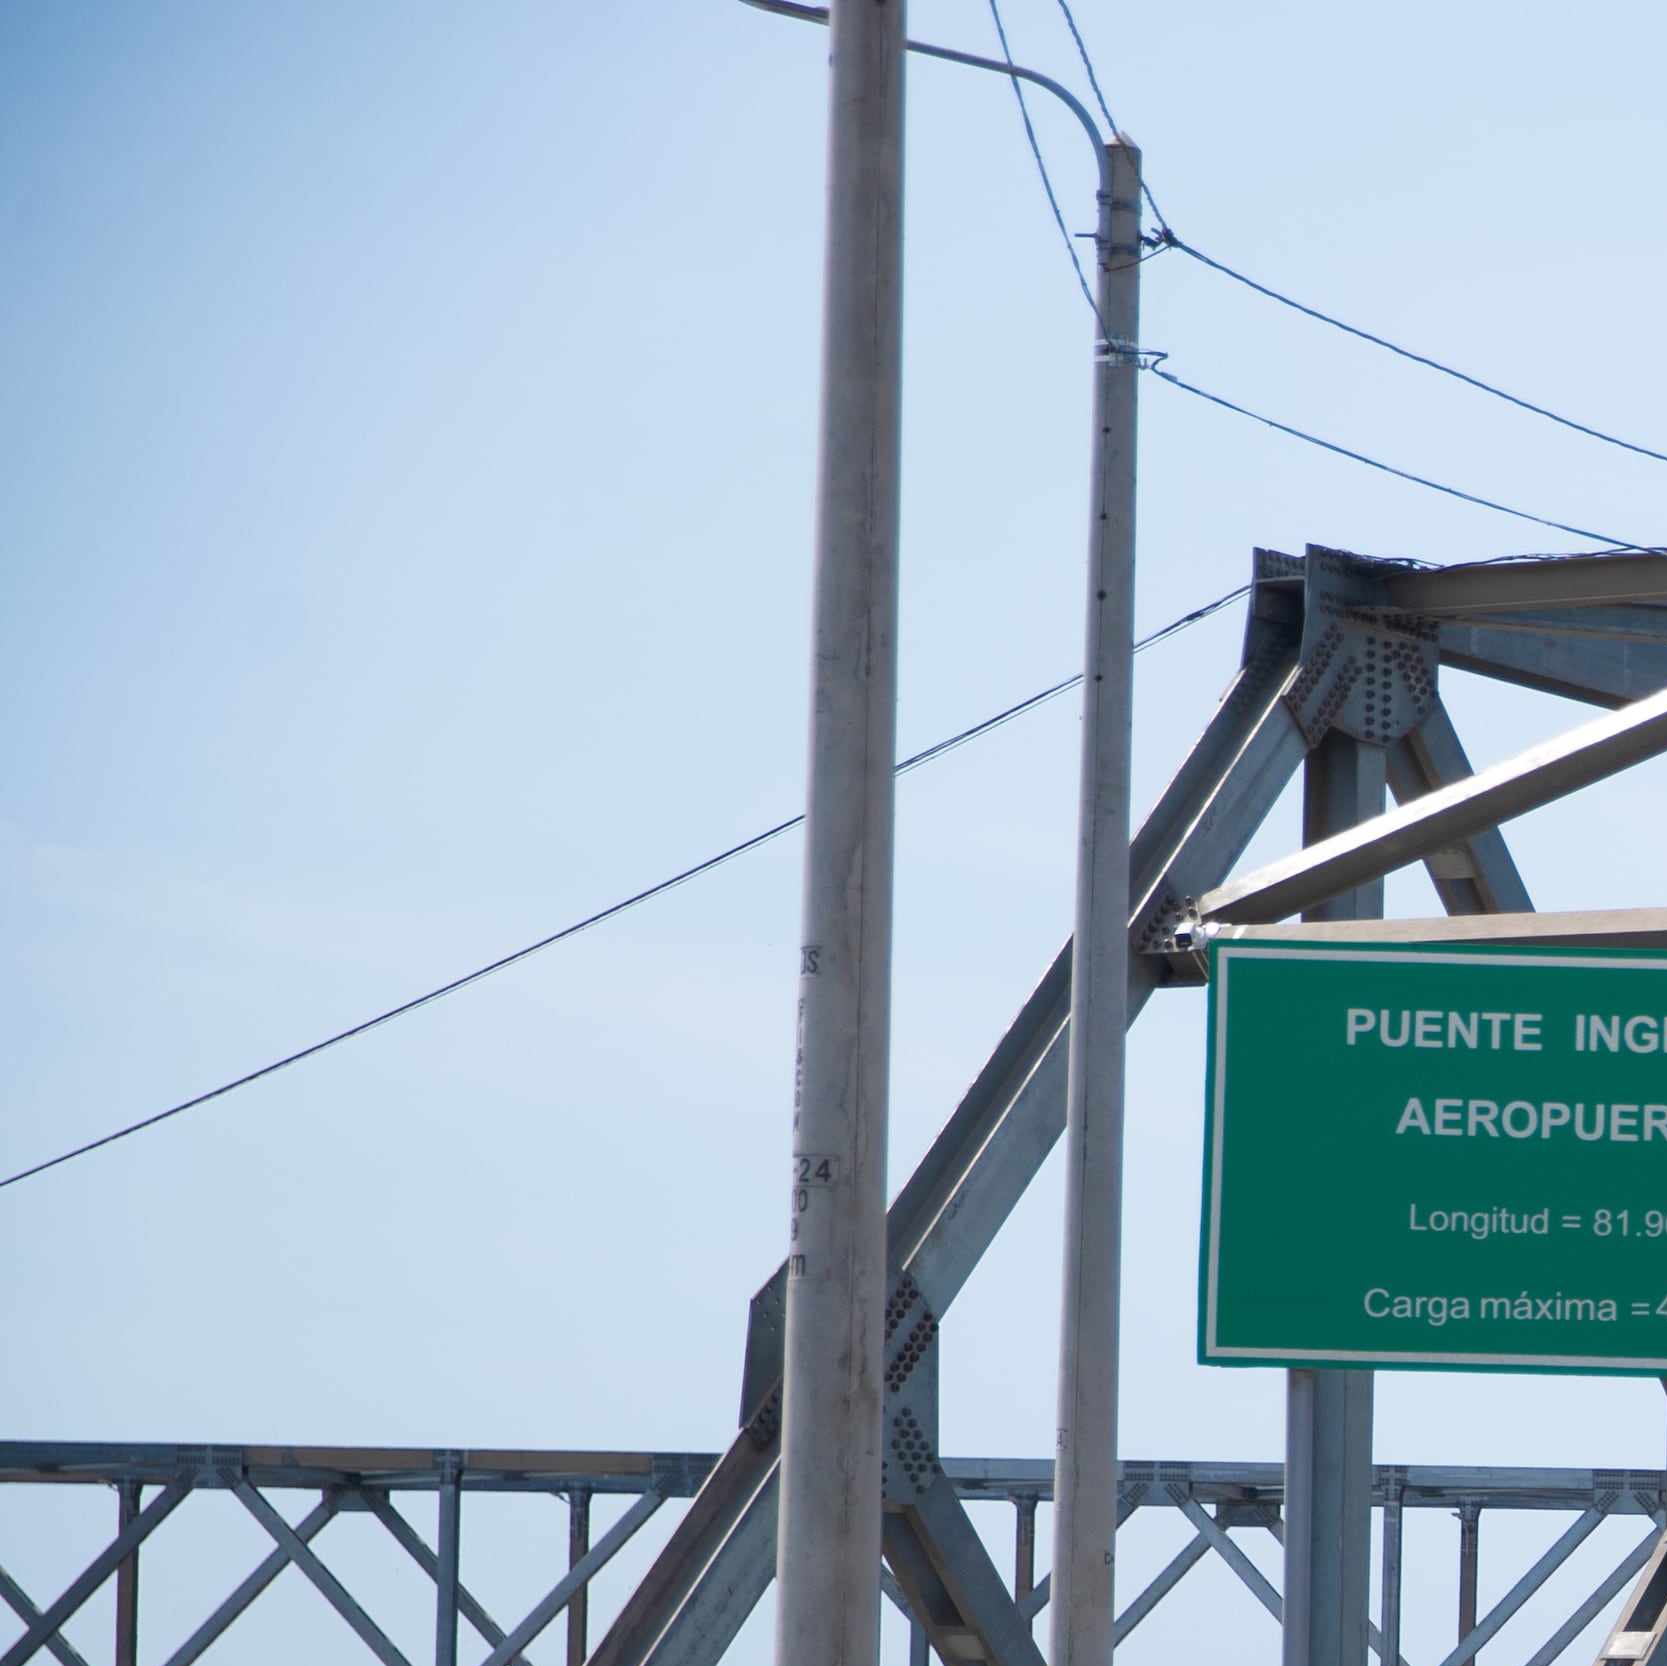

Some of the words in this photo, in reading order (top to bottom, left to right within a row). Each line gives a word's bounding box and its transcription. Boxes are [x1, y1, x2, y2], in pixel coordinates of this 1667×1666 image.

[1346, 1008, 1543, 1051] PUENTE
[1410, 1203, 1549, 1240] Longitud
[1562, 1215, 1581, 1229] =
[1364, 1287, 1470, 1326] Carga
[1480, 1291, 1617, 1322] máxima
